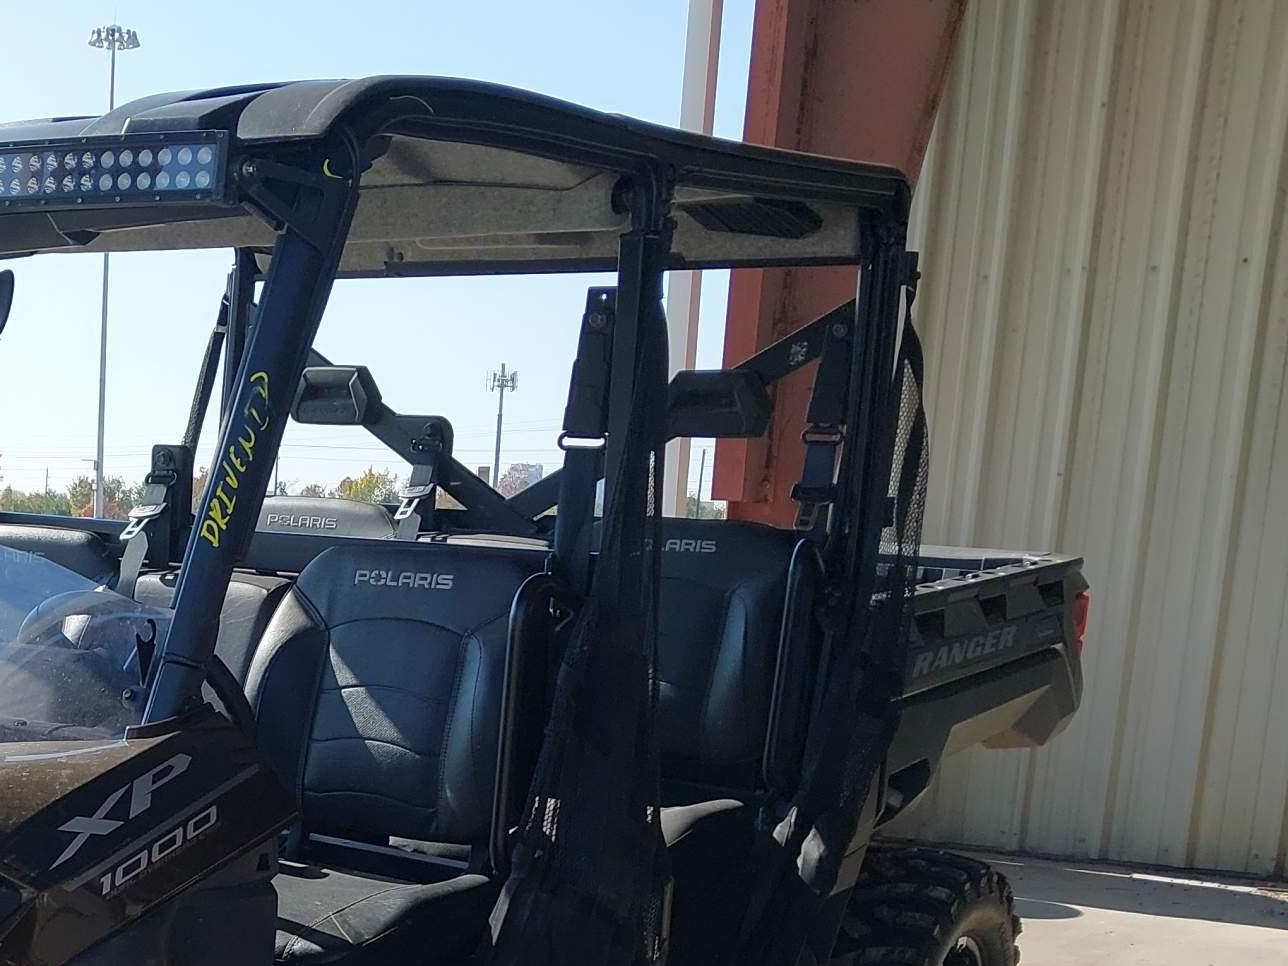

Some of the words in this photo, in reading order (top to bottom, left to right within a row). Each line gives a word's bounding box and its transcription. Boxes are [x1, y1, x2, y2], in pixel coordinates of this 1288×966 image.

[200, 424, 257, 549] DRIVEN
[266, 512, 338, 529] POLARIS
[354, 568, 455, 590] POLARIS
[911, 624, 1020, 679] RANGER
[47, 752, 193, 871] XP
[98, 804, 218, 896] 1000
